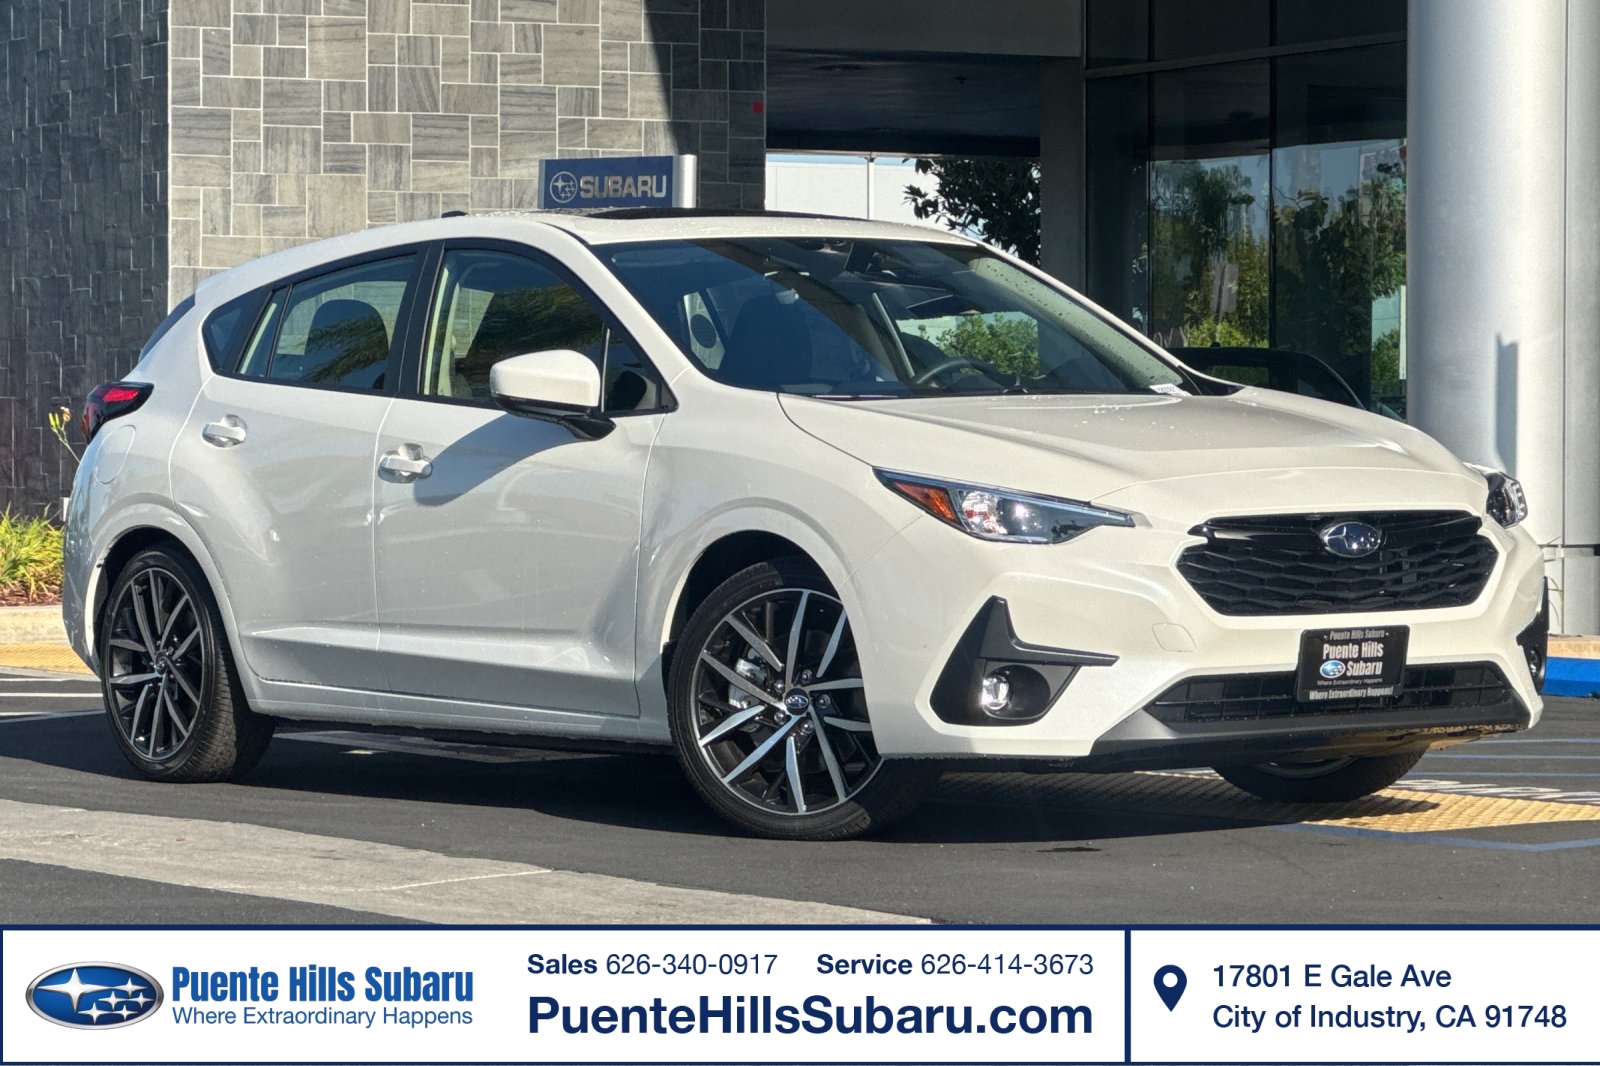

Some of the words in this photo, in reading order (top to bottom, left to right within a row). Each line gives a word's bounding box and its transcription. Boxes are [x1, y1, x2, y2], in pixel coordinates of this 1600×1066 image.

[580, 175, 667, 198] SUBARU
[1329, 630, 1350, 640] Puente
[1351, 629, 1364, 640] Hills
[1365, 629, 1385, 639] Subaru
[1322, 642, 1359, 659] Puente
[1361, 641, 1384, 658] Hills
[1346, 661, 1383, 676] Subaru
[1309, 690, 1328, 700] Where
[1328, 688, 1366, 699] Extraordinary
